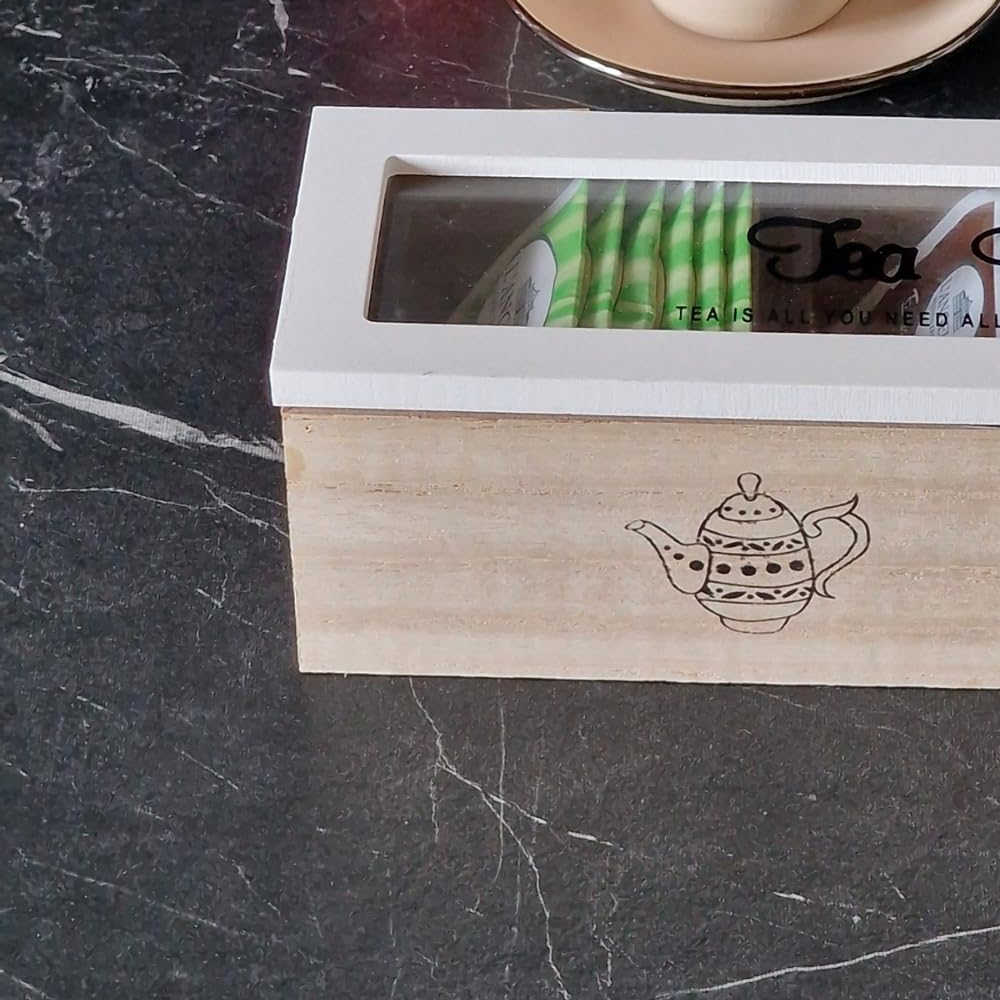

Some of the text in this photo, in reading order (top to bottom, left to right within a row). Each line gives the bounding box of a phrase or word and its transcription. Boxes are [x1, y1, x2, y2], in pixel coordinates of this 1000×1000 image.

[747, 216, 922, 284] Tea
[676, 306, 719, 321] TEA
[733, 307, 753, 323] IS
[768, 308, 811, 325] ALL
[825, 310, 871, 326] YOU
[886, 311, 948, 327] NEED
